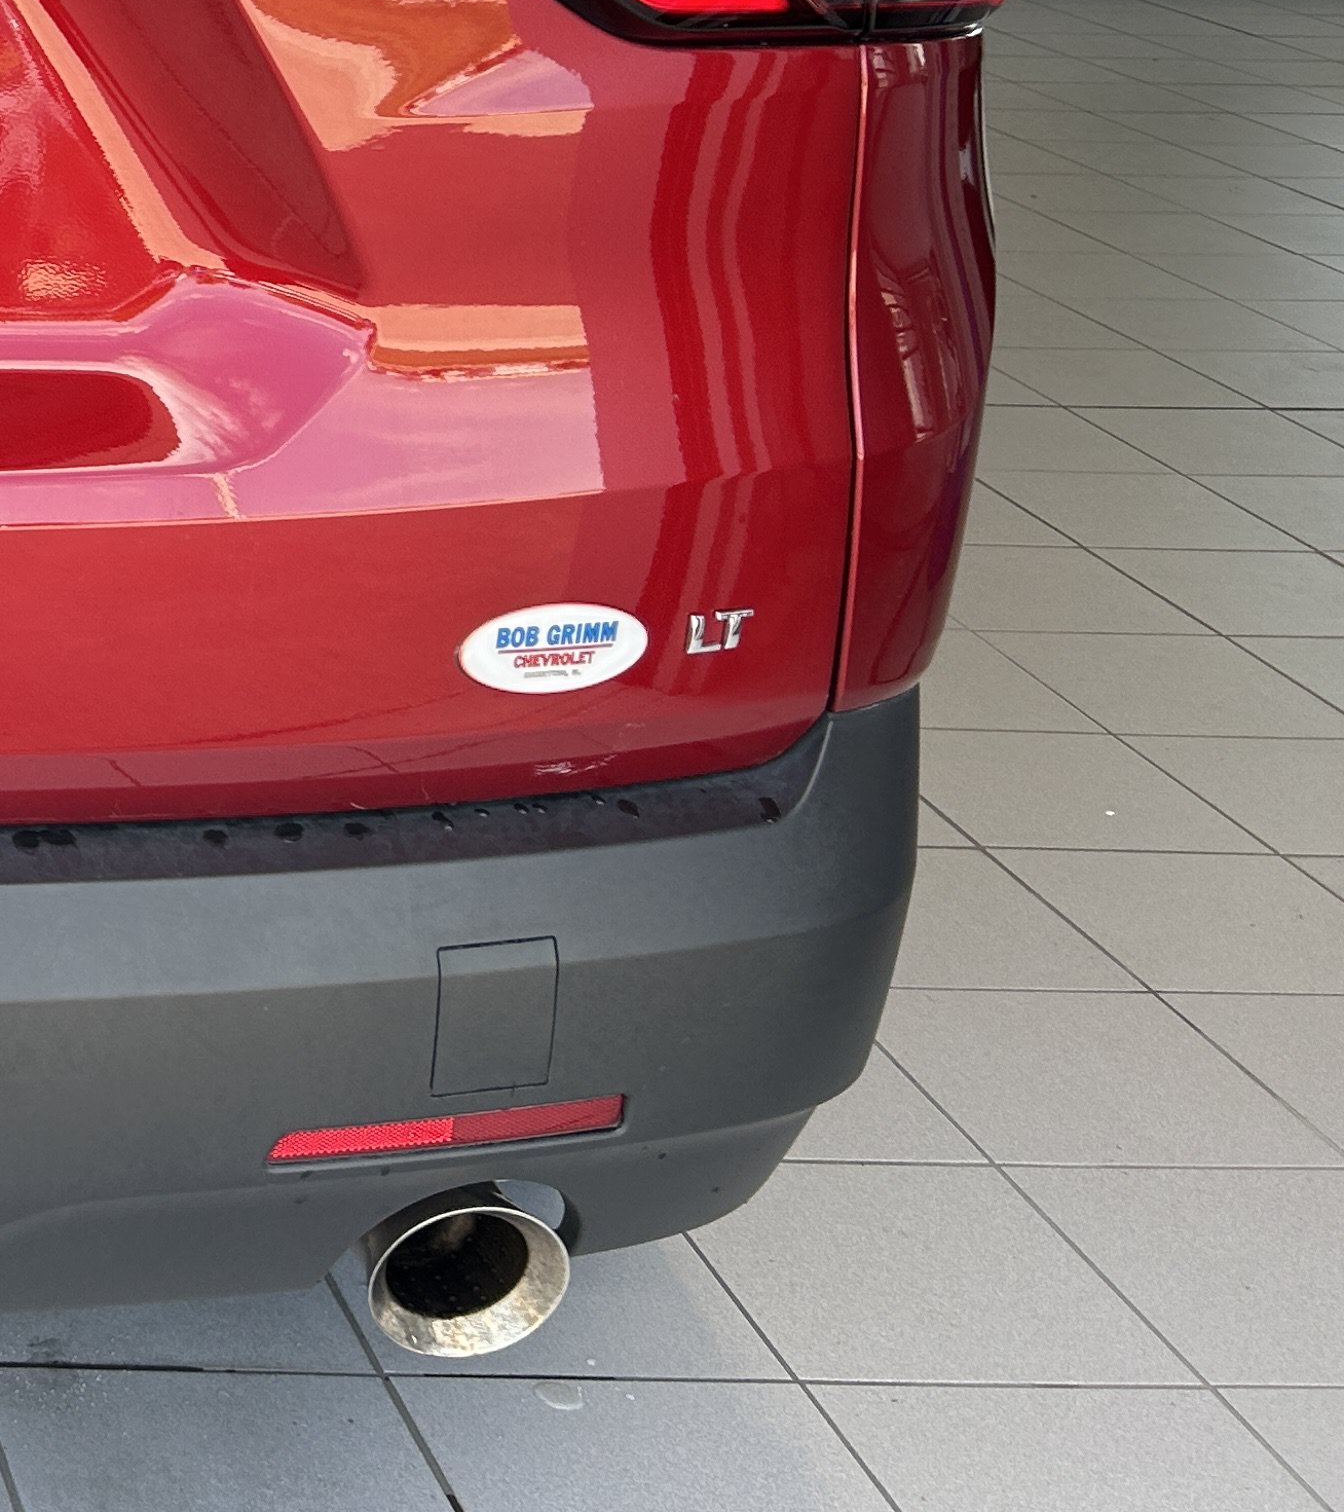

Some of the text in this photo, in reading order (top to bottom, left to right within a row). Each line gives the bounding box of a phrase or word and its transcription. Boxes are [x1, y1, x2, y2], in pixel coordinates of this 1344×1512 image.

[496, 620, 619, 650] BOB GRIMM
[686, 607, 755, 655] LT
[513, 650, 596, 669] CHEVROLET
